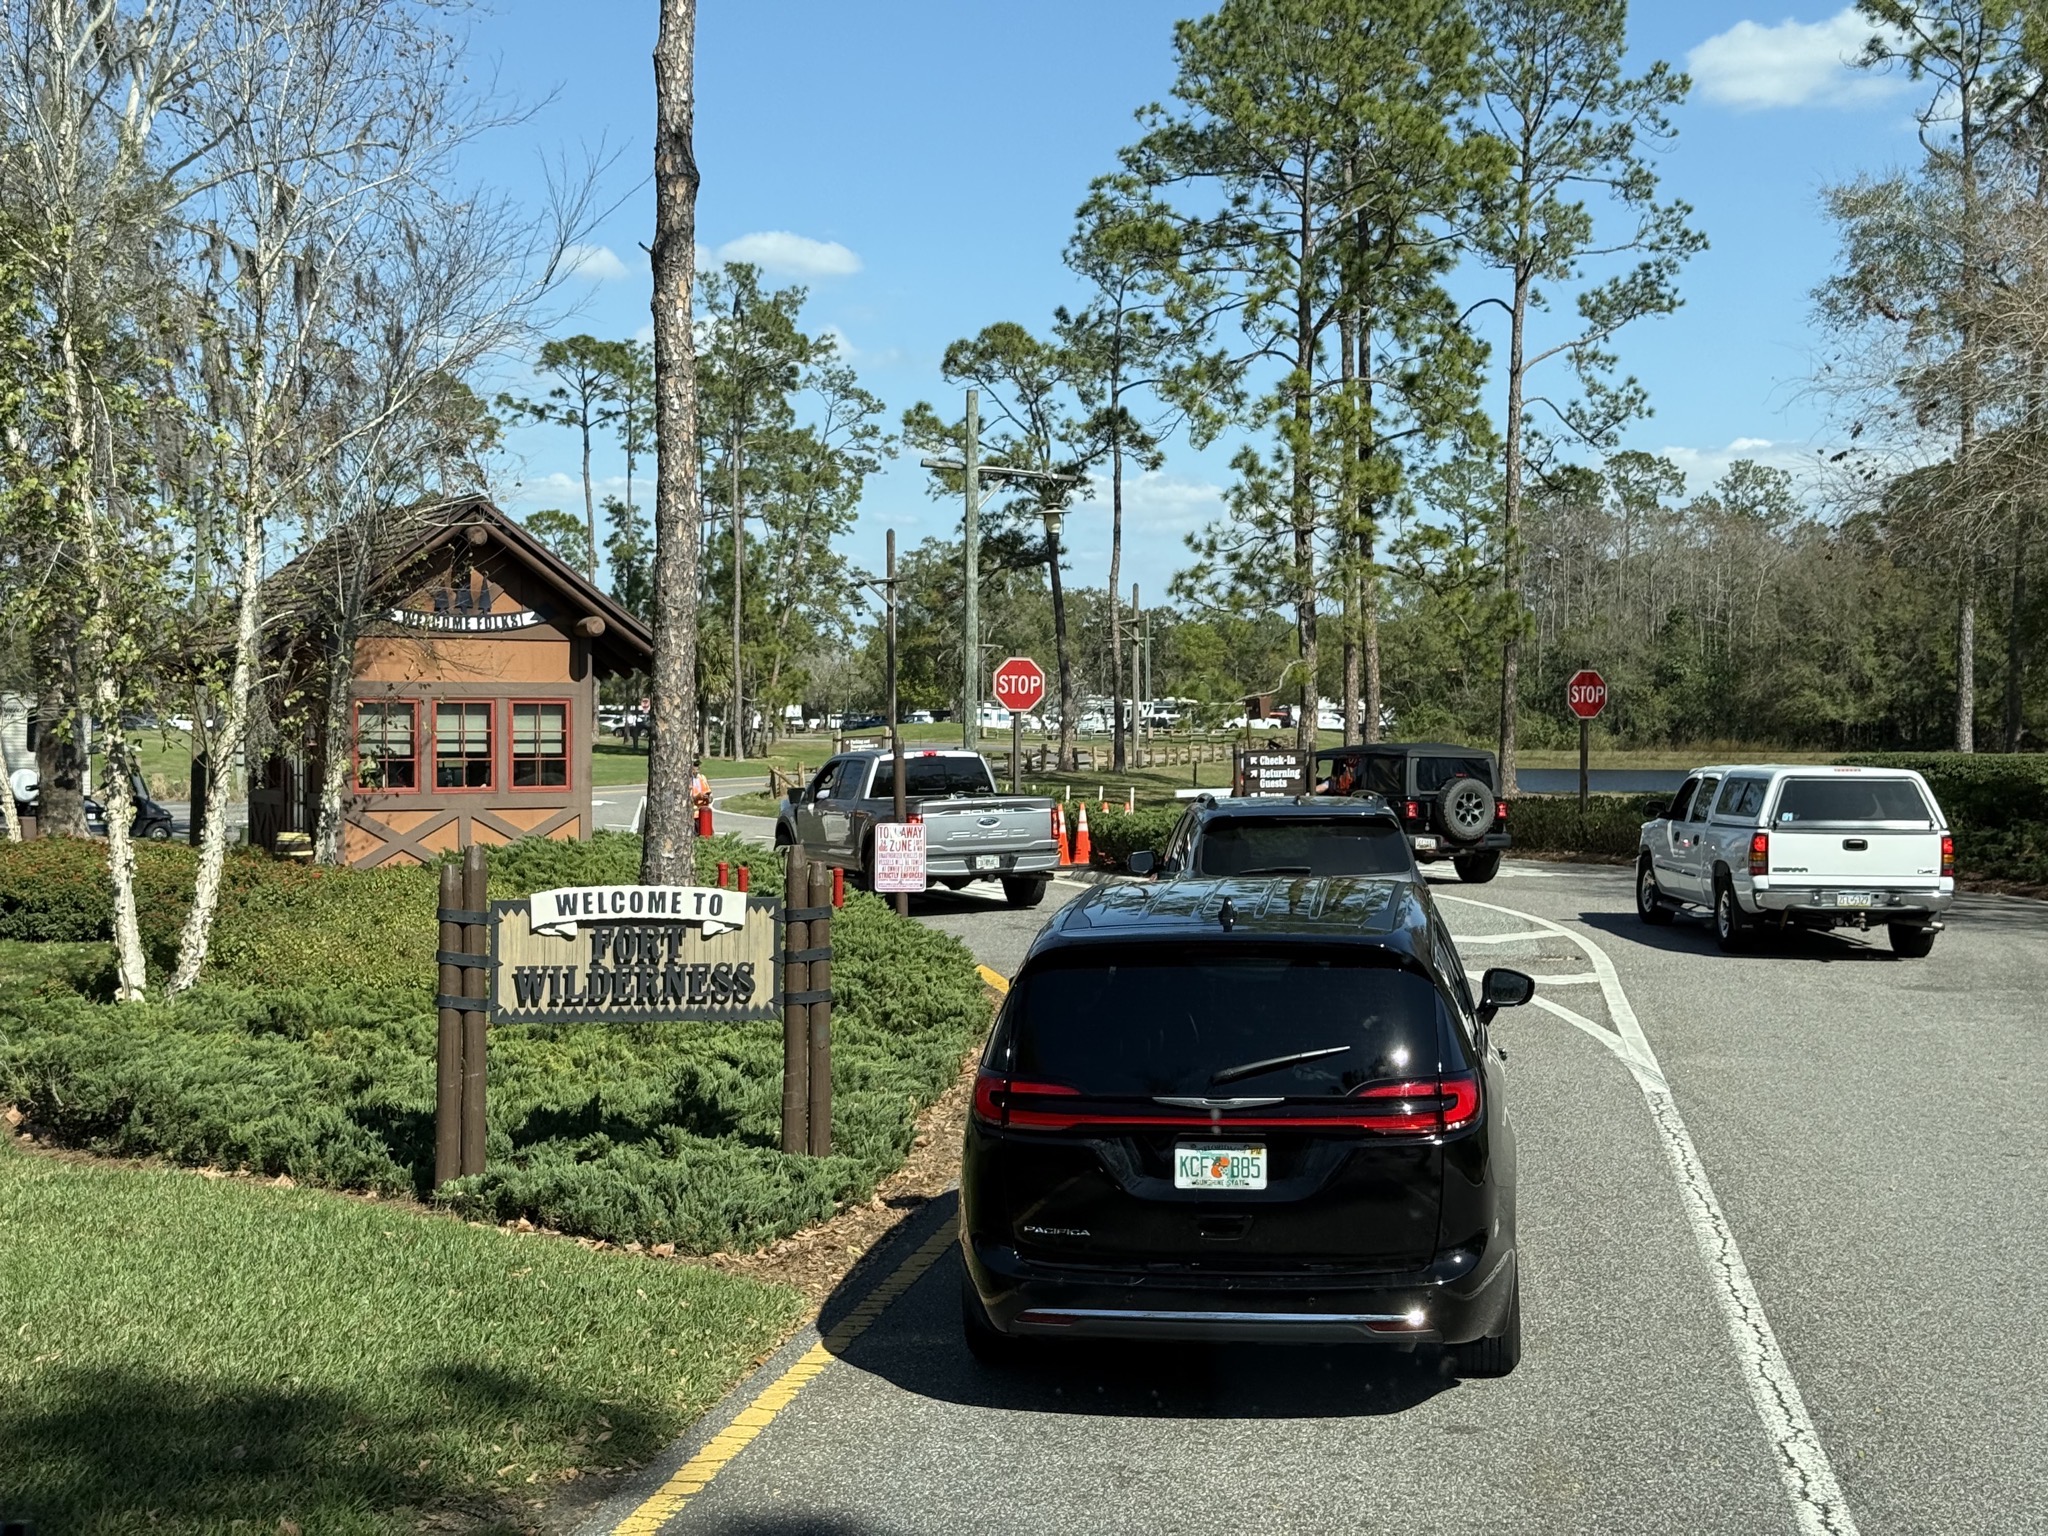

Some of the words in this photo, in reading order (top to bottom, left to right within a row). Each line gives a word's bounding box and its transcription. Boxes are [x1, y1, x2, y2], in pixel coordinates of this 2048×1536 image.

[998, 674, 1041, 695] STOP
[1570, 685, 1605, 704] STOP
[1260, 754, 1297, 766] Check-In
[1260, 768, 1301, 780] Returning
[1260, 779, 1288, 789] Guests
[889, 839, 913, 852] ZONE
[555, 890, 682, 917] WELCOME
[694, 892, 724, 917] TO
[590, 924, 687, 962] FORT
[514, 961, 757, 1003] WILDERNESS
[1180, 1156, 1209, 1178] KCF
[1226, 1179, 1246, 1187] STATE
[1023, 1225, 1091, 1237] PACIFICA
